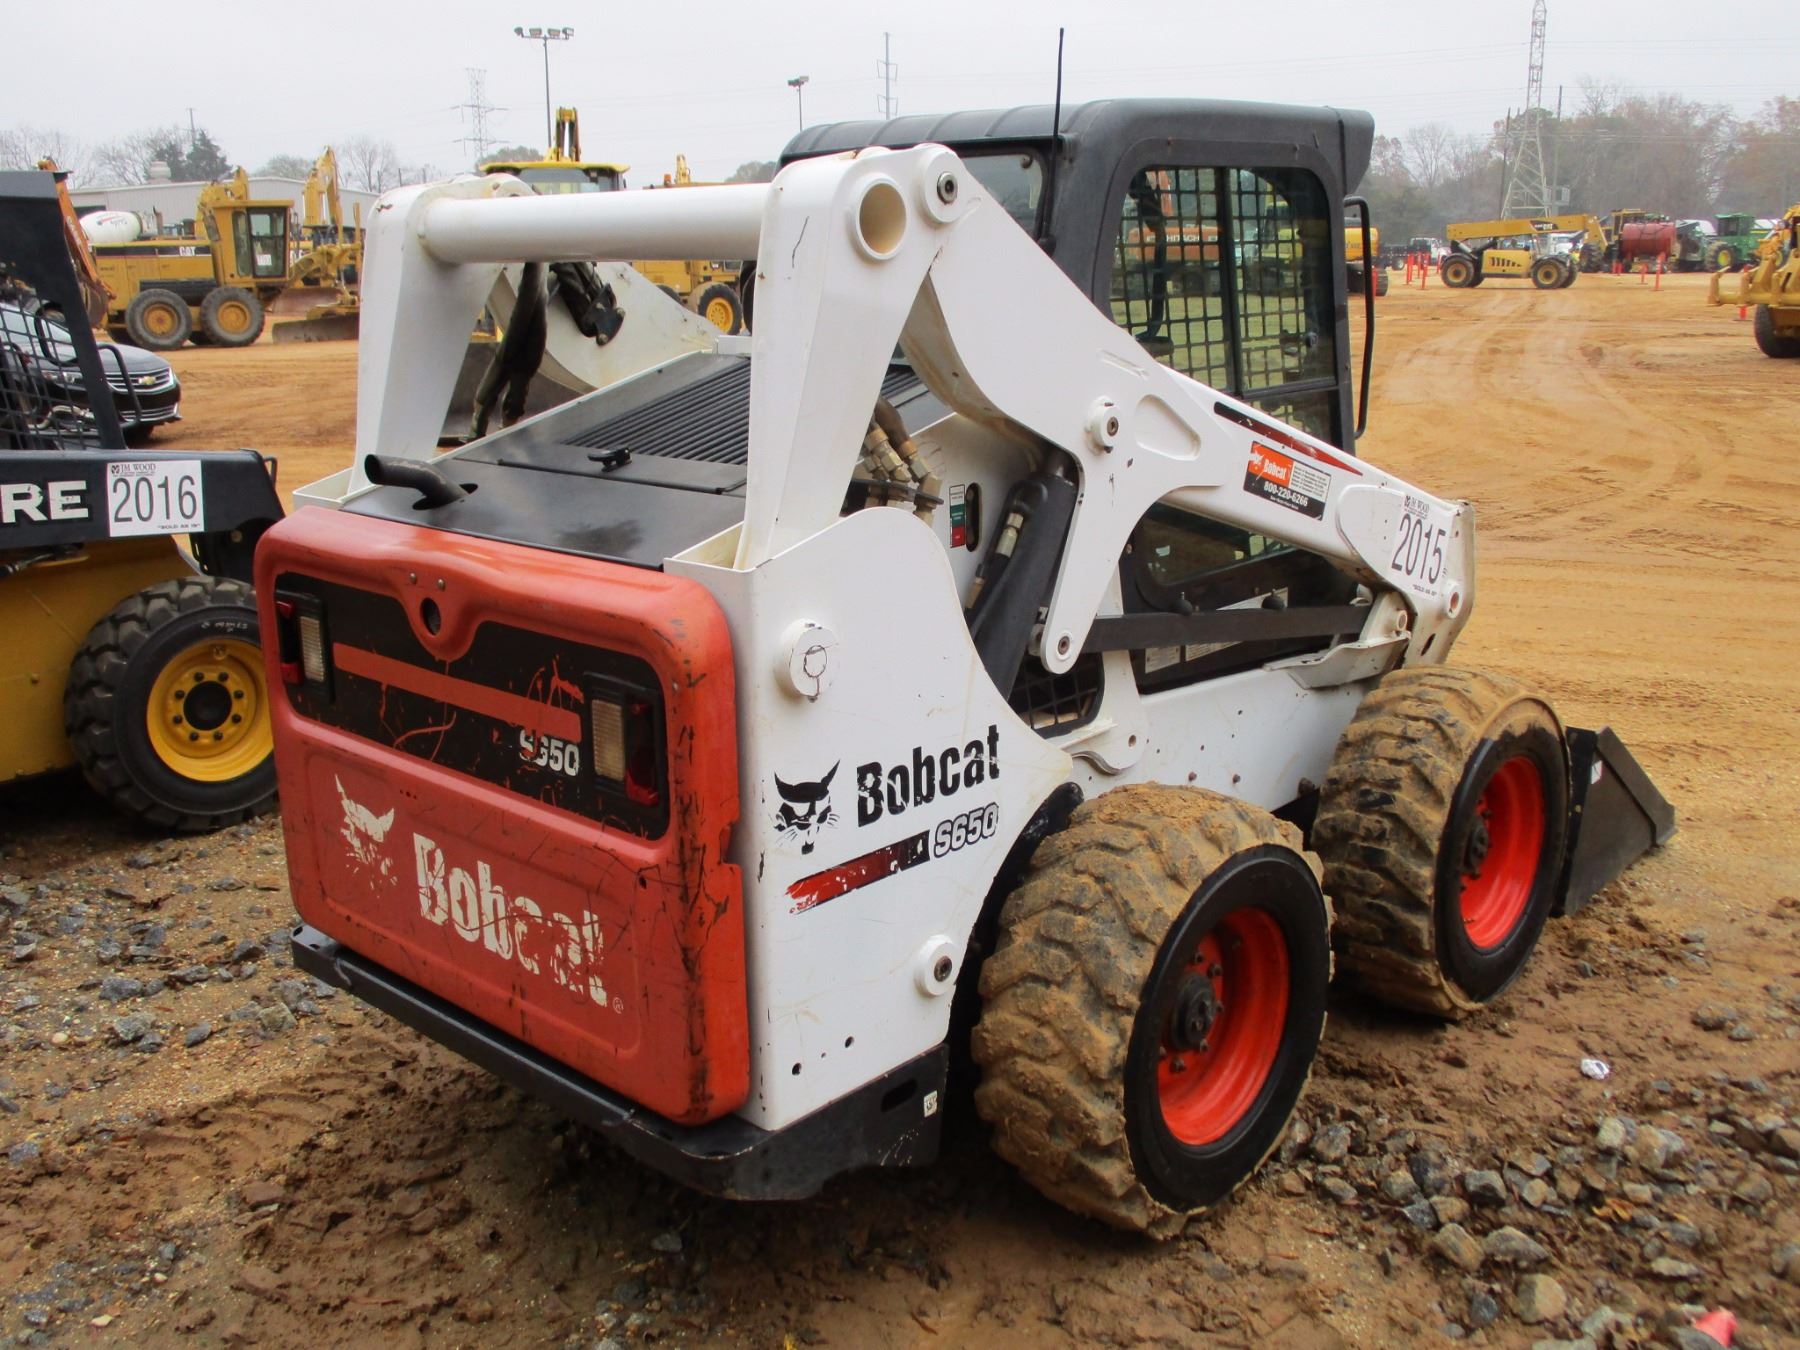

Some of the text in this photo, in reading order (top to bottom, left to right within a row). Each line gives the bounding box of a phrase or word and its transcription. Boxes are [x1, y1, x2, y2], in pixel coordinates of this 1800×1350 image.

[133, 463, 156, 472] WOOD
[1263, 458, 1287, 481] Bobcat
[0, 480, 89, 523] RE
[112, 475, 197, 523] 2016
[1391, 513, 1446, 584] 2015
[856, 724, 1000, 828] Bobcat
[933, 801, 999, 858] S650
